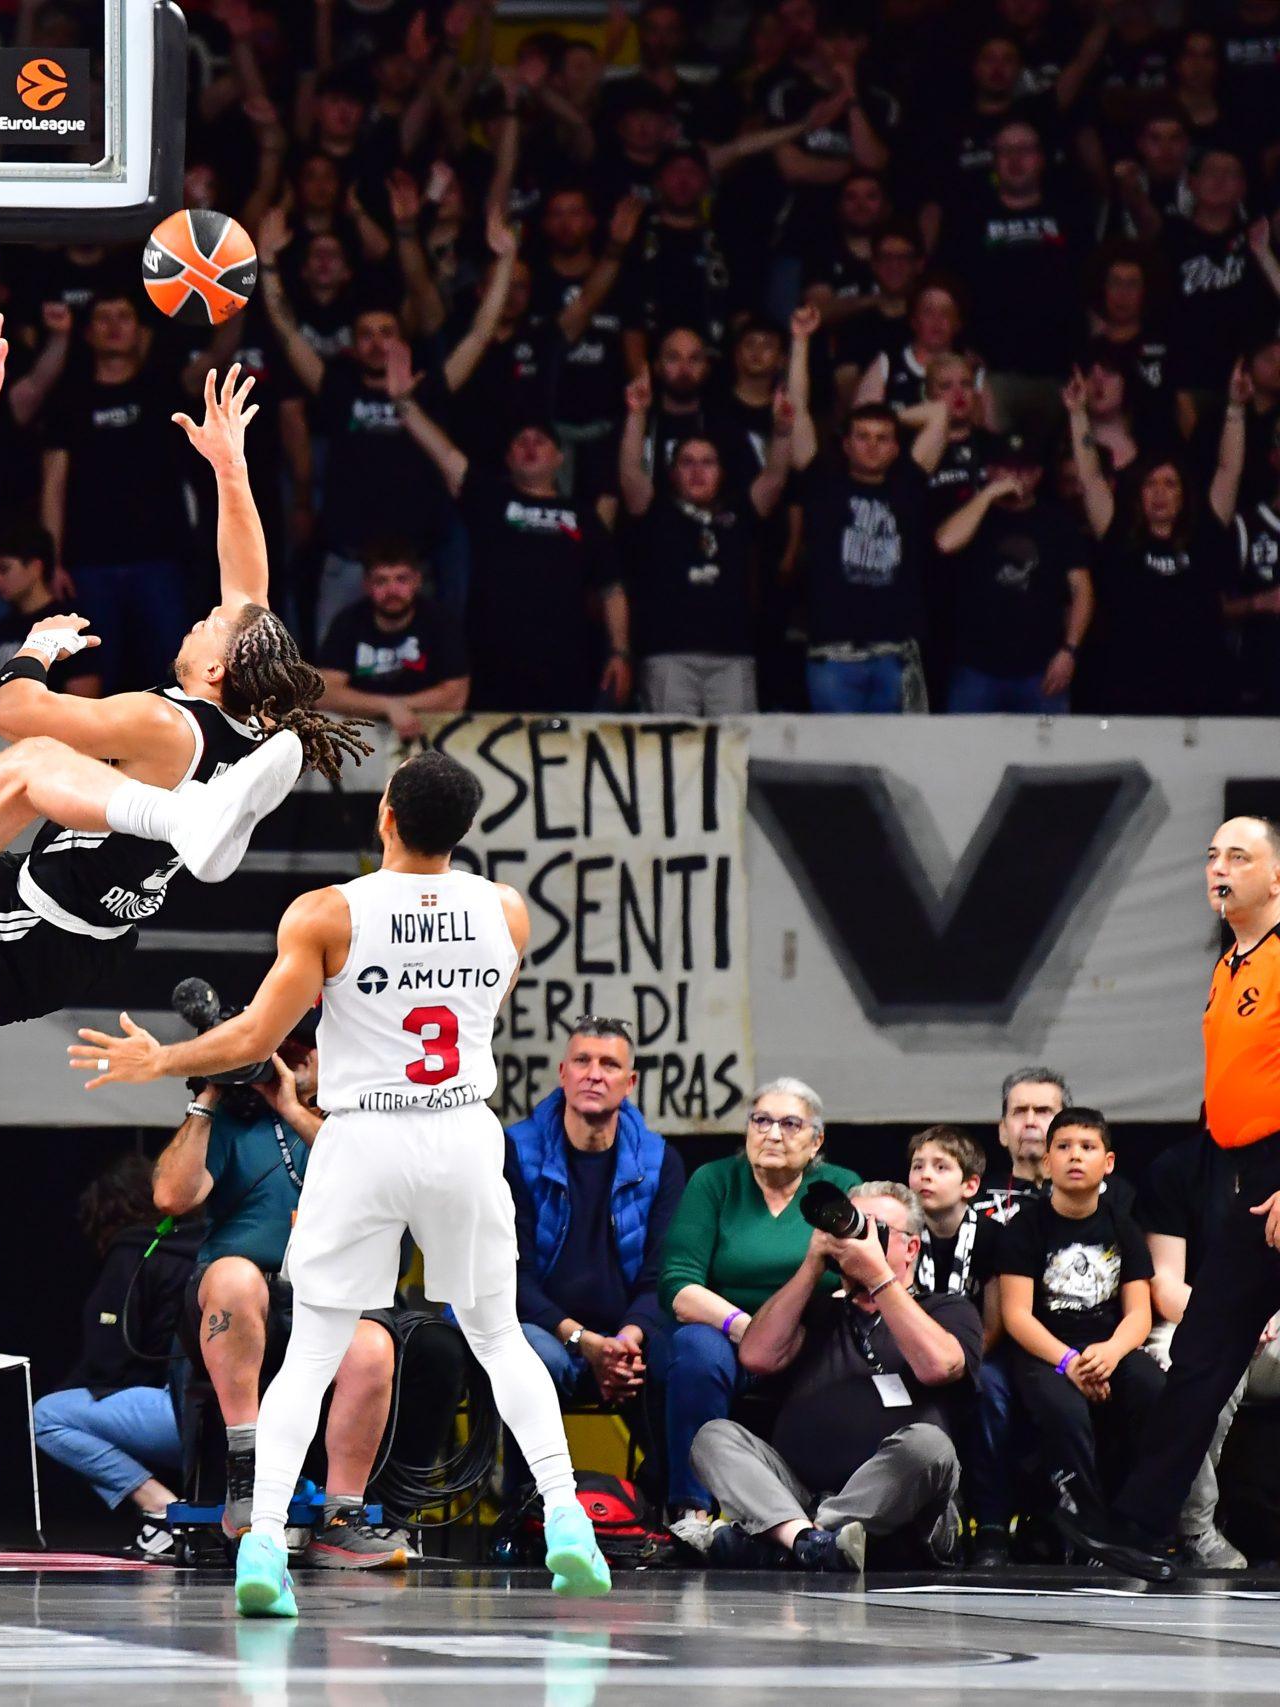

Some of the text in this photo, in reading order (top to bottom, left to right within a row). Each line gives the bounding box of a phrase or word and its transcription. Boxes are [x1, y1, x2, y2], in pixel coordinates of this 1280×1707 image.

[747, 760, 1280, 1026] V
[391, 910, 476, 944] NOWELL
[398, 968, 500, 990] AMUTIO
[402, 1005, 460, 1085] 3
[633, 981, 689, 1046] DI
